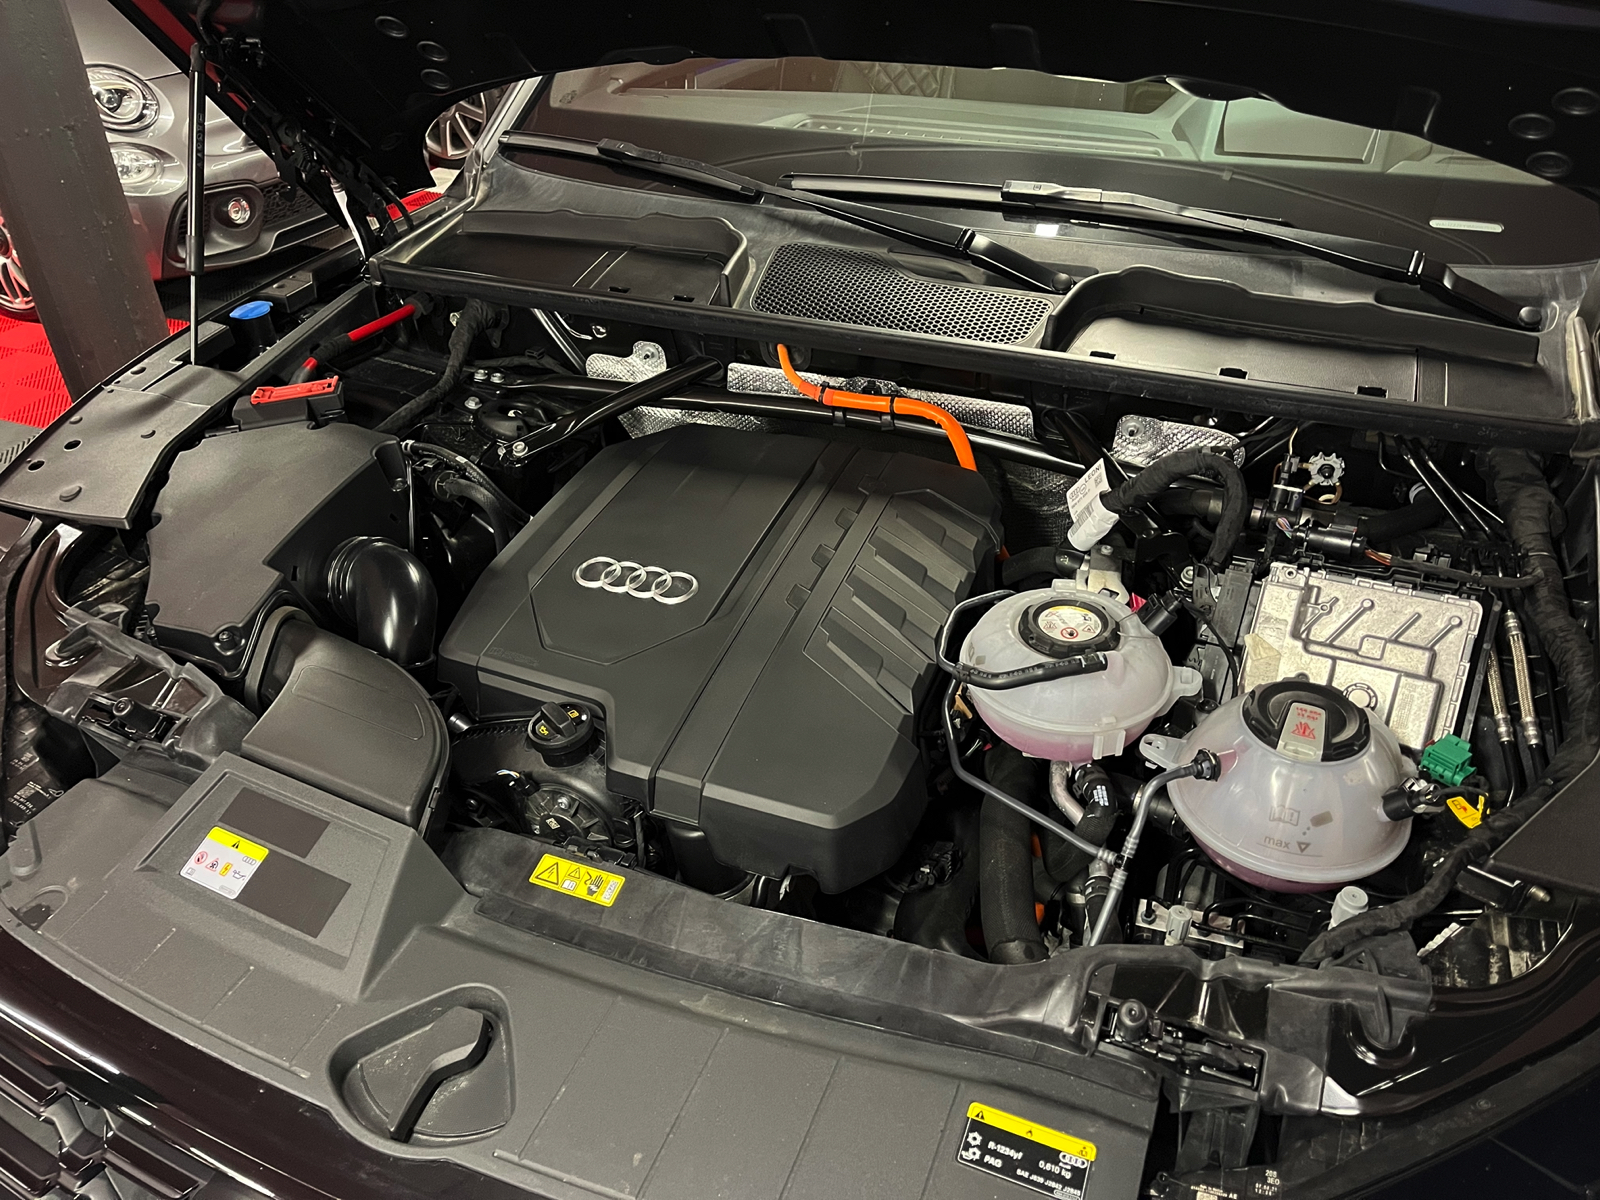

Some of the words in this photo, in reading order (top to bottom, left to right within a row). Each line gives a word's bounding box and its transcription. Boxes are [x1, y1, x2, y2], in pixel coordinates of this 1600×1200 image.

[1084, 464, 1102, 483] LEONI
[1264, 836, 1290, 849] max
[987, 1141, 1023, 1160] R-1234yf
[983, 1155, 1003, 1168] PAG
[1061, 1168, 1072, 1180] kg
